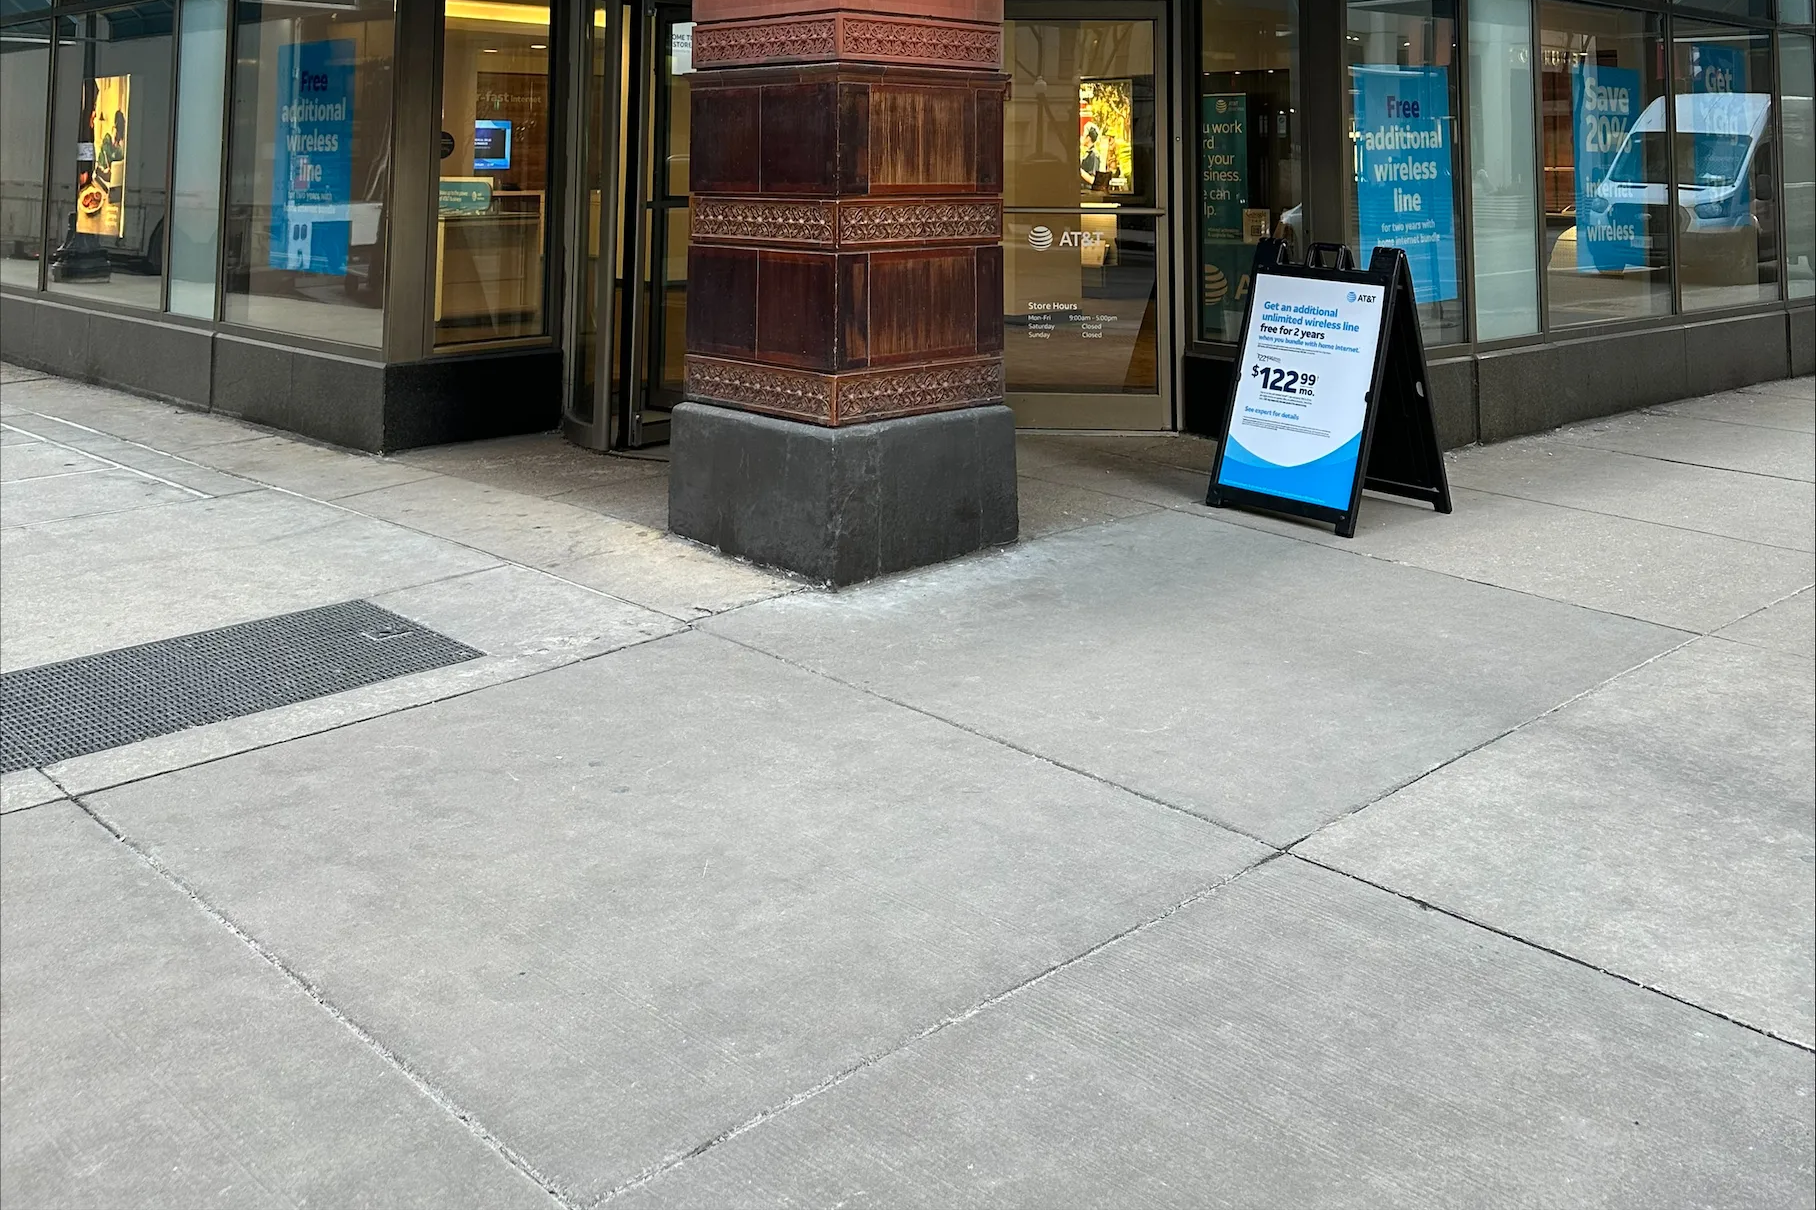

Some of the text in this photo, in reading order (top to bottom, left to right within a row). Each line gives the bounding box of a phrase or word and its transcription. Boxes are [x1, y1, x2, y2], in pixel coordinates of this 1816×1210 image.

[301, 71, 329, 92] Free
[1705, 65, 1733, 94] Get
[1585, 77, 1630, 115] Save
[281, 97, 347, 123] additional
[1386, 95, 1420, 119] Free
[1212, 120, 1243, 134] work
[1585, 114, 1633, 154] 20%
[286, 128, 339, 153] wireless
[1365, 119, 1443, 151] additional
[1203, 136, 1215, 150] rd
[1208, 154, 1235, 168] your
[1203, 169, 1242, 182] siness.
[1374, 156, 1438, 182] wireless
[1209, 190, 1231, 201] can
[1393, 188, 1422, 213] line
[1203, 205, 1217, 219] lp.
[1381, 219, 1436, 233] for two years with
[1586, 221, 1635, 242] wireless
[1059, 231, 1104, 247] AT&T
[1395, 235, 1420, 246] internet
[1420, 232, 1440, 243] bundle
[1028, 302, 1078, 310] Store Hours
[1357, 294, 1377, 303] AT&T
[1264, 301, 1338, 318] Get an additional
[1028, 323, 1056, 331] Saturday
[1262, 313, 1360, 332] unlimited wireless line
[1028, 331, 1051, 339] Sunday
[1260, 323, 1326, 340] free for 2 years
[1285, 337, 1304, 346] bundle
[1304, 339, 1318, 347] with
[1318, 340, 1335, 349] home
[1298, 387, 1315, 397] mo.
[1255, 407, 1272, 416] expert
[1272, 409, 1281, 417] for
[1281, 411, 1300, 420] details
